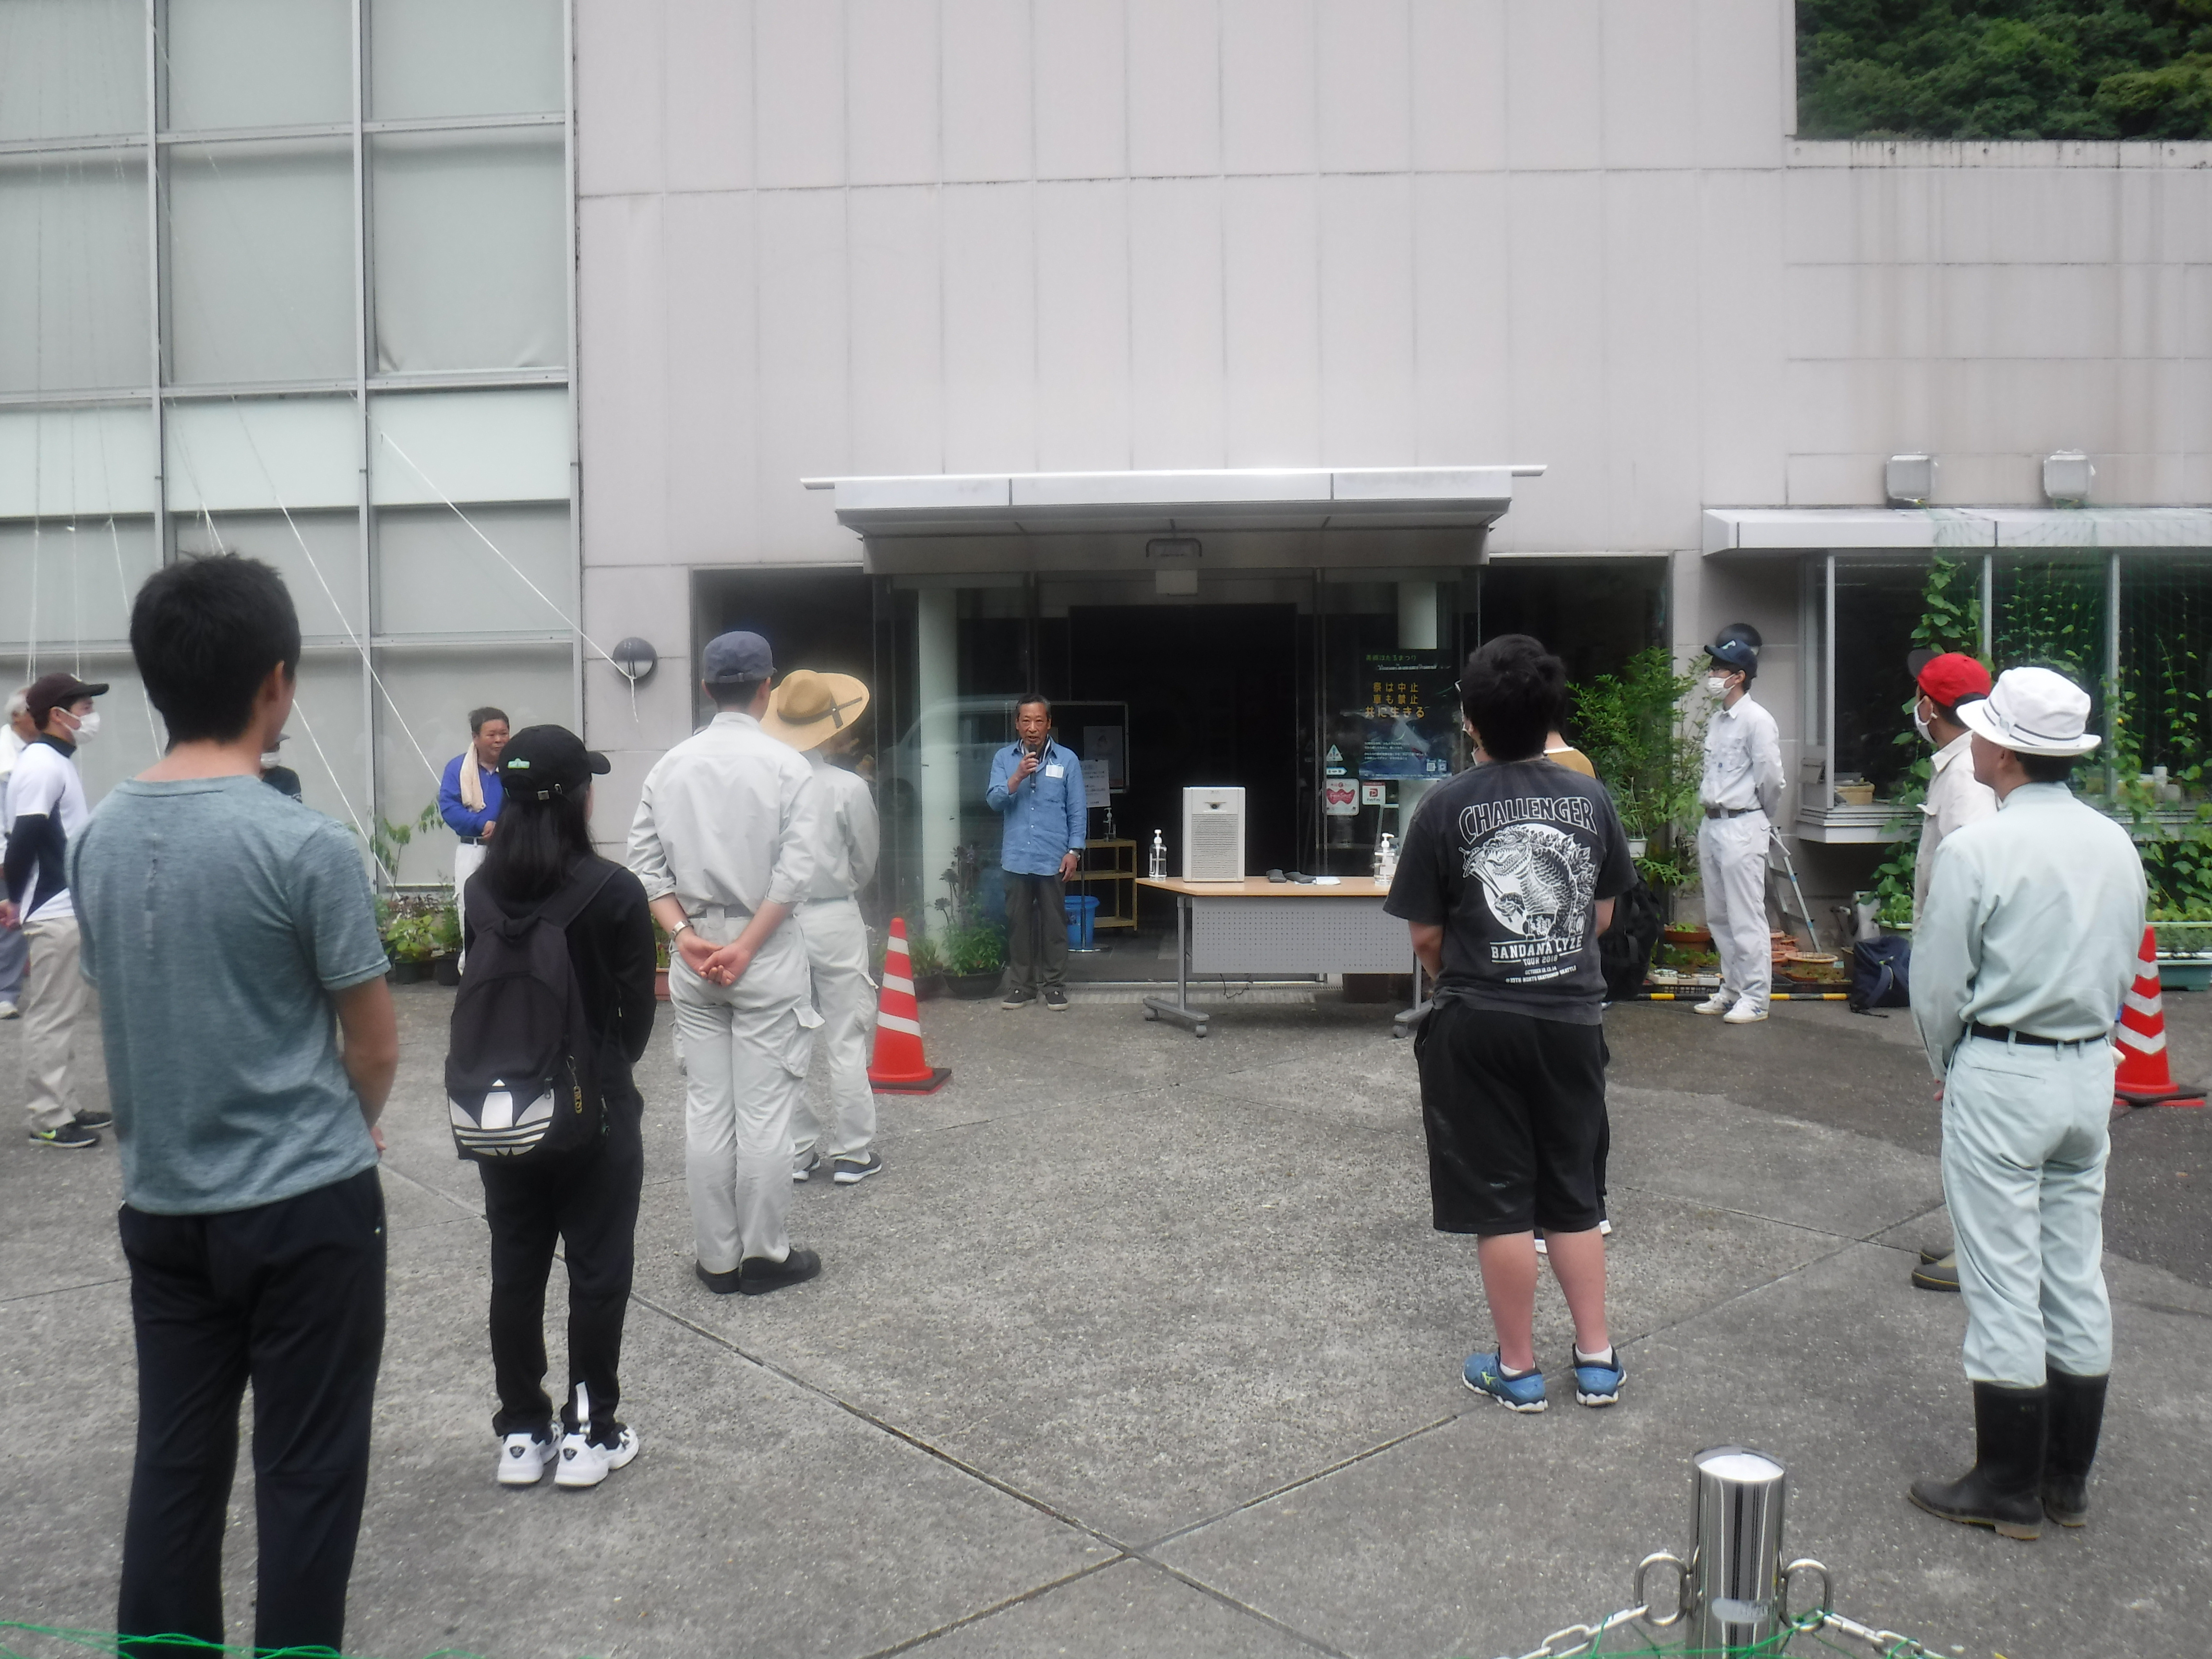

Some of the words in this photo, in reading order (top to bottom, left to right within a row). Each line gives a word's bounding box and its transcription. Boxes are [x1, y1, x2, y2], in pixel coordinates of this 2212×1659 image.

[1373, 682, 1419, 692] 祭は中止
[1365, 706, 1425, 718] 共に生きる
[1458, 796, 1598, 845] CHALLENGER
[1523, 957, 1540, 966] TOUR
[1542, 954, 1558, 964] 2018
